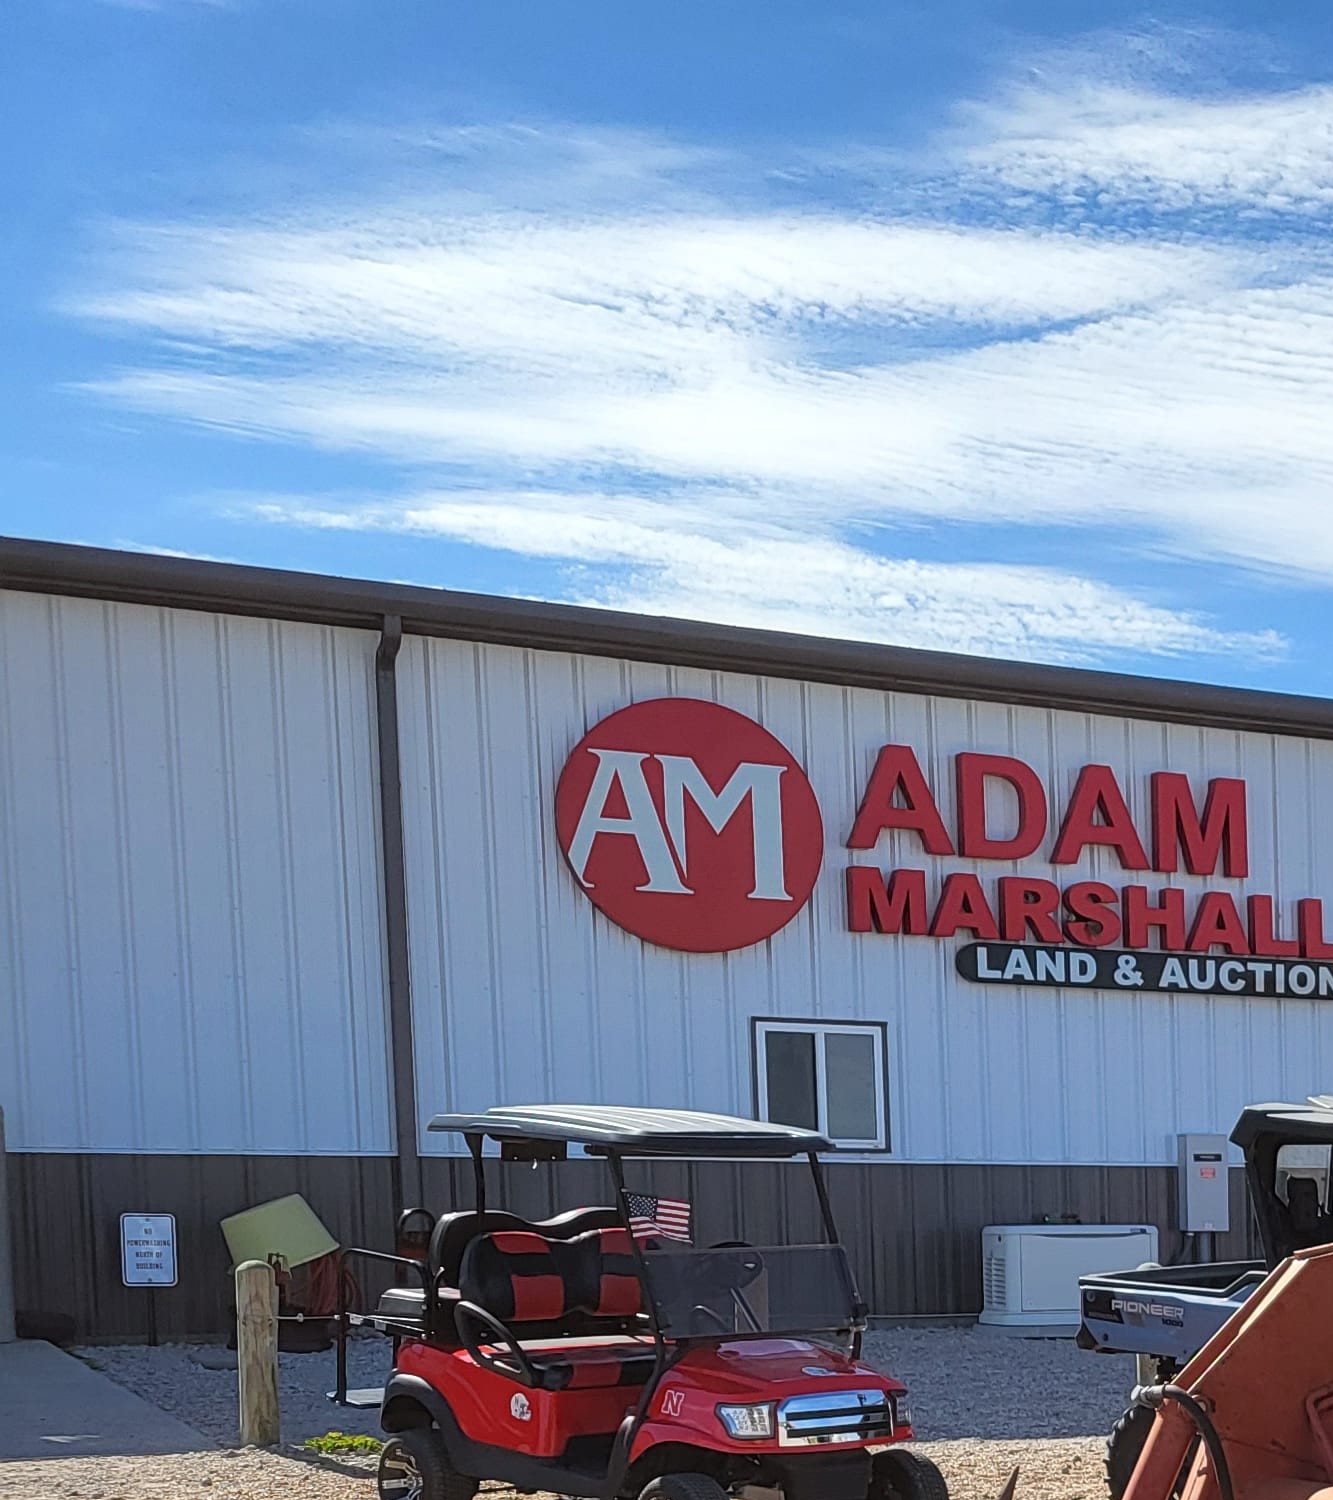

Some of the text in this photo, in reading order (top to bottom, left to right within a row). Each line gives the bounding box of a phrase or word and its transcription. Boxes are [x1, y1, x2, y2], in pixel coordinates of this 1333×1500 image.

[568, 748, 795, 901] AM
[847, 744, 1248, 878] ADAM
[976, 947, 1096, 983] LAND
[1113, 955, 1144, 986] &
[1111, 1300, 1184, 1318] PIONEER
[661, 1389, 685, 1417] N
